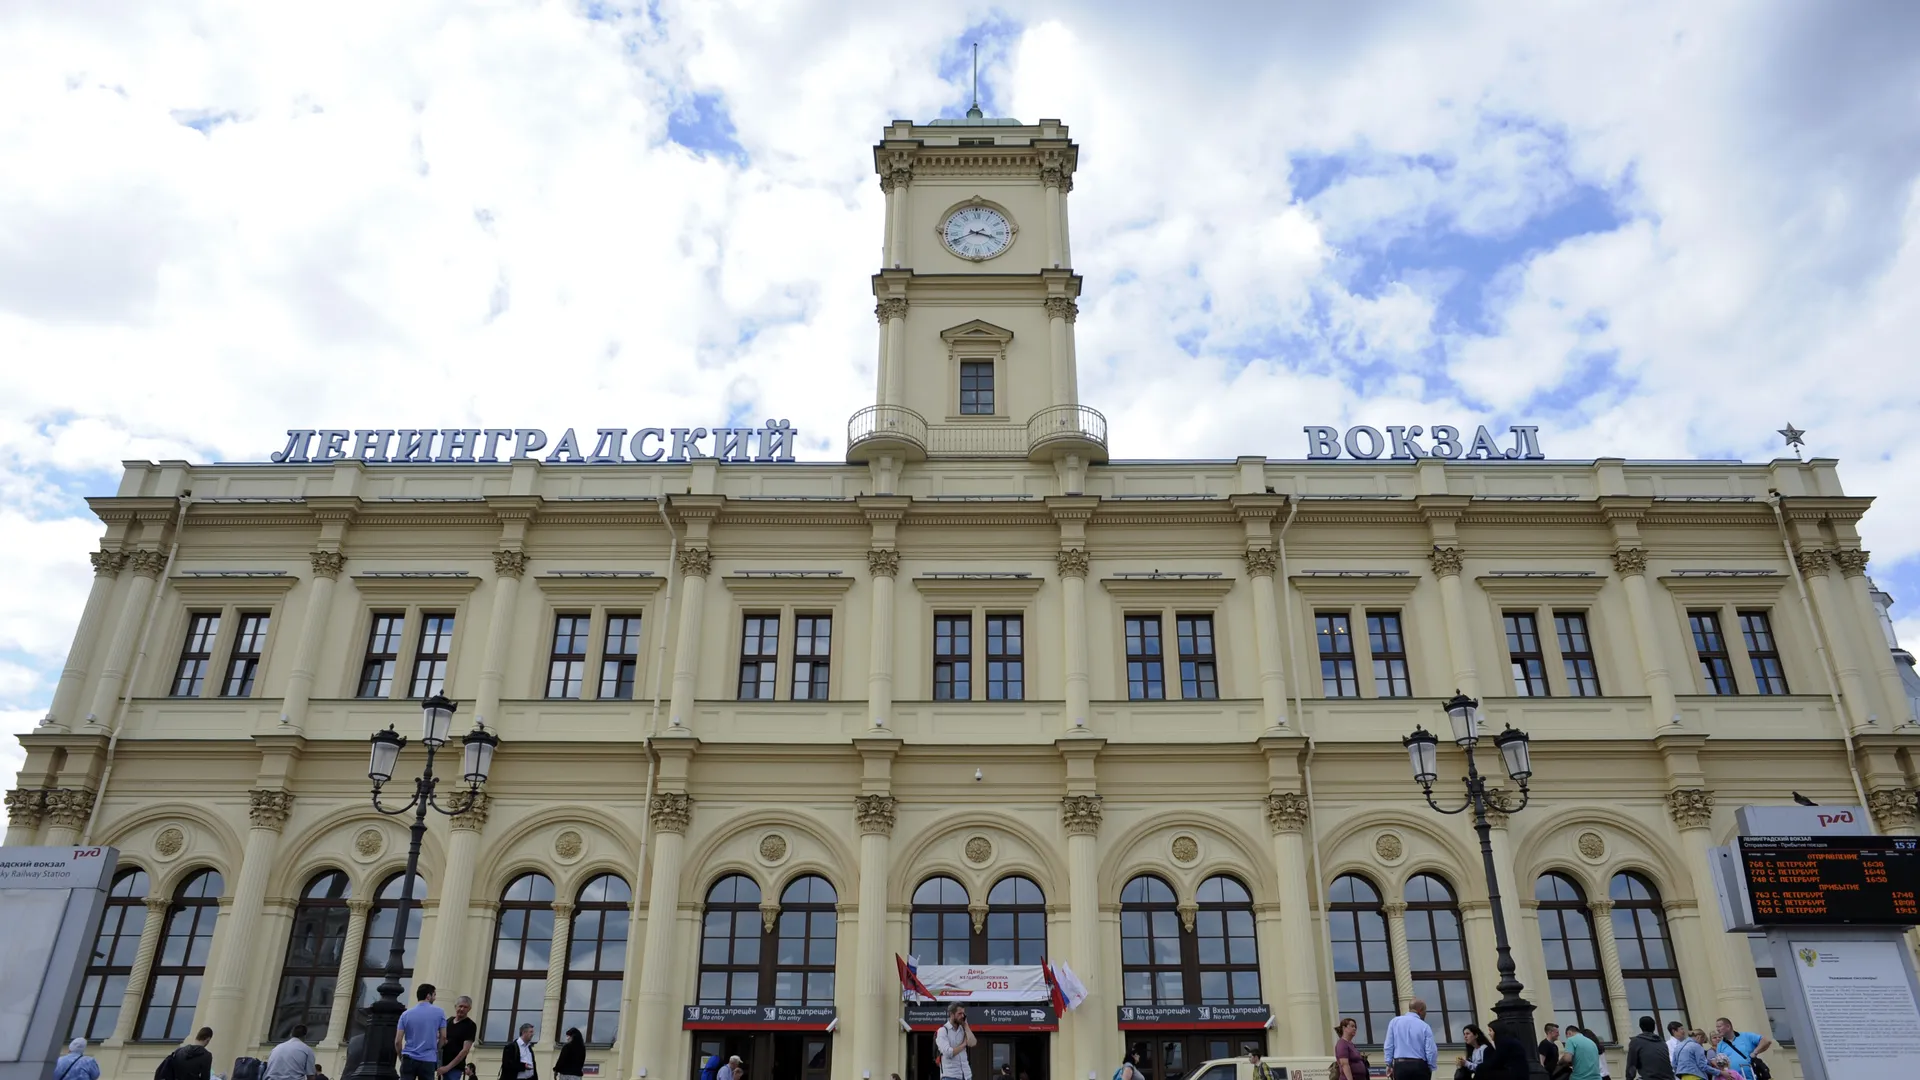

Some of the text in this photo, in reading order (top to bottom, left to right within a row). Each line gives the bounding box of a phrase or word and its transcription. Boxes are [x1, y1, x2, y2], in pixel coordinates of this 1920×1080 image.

[271, 419, 1545, 463] ЛЕНИНГРАДСКИЙ ВОКЗАЛ
[11, 870, 41, 879] Railway
[42, 870, 70, 878] Station
[986, 981, 1009, 990] 2015
[702, 1007, 757, 1016] Вход запрещён
[778, 1007, 833, 1017] Вход запрещён
[1136, 1007, 1191, 1016] Вход запрещён
[1212, 1006, 1267, 1015] Вход запрещён
